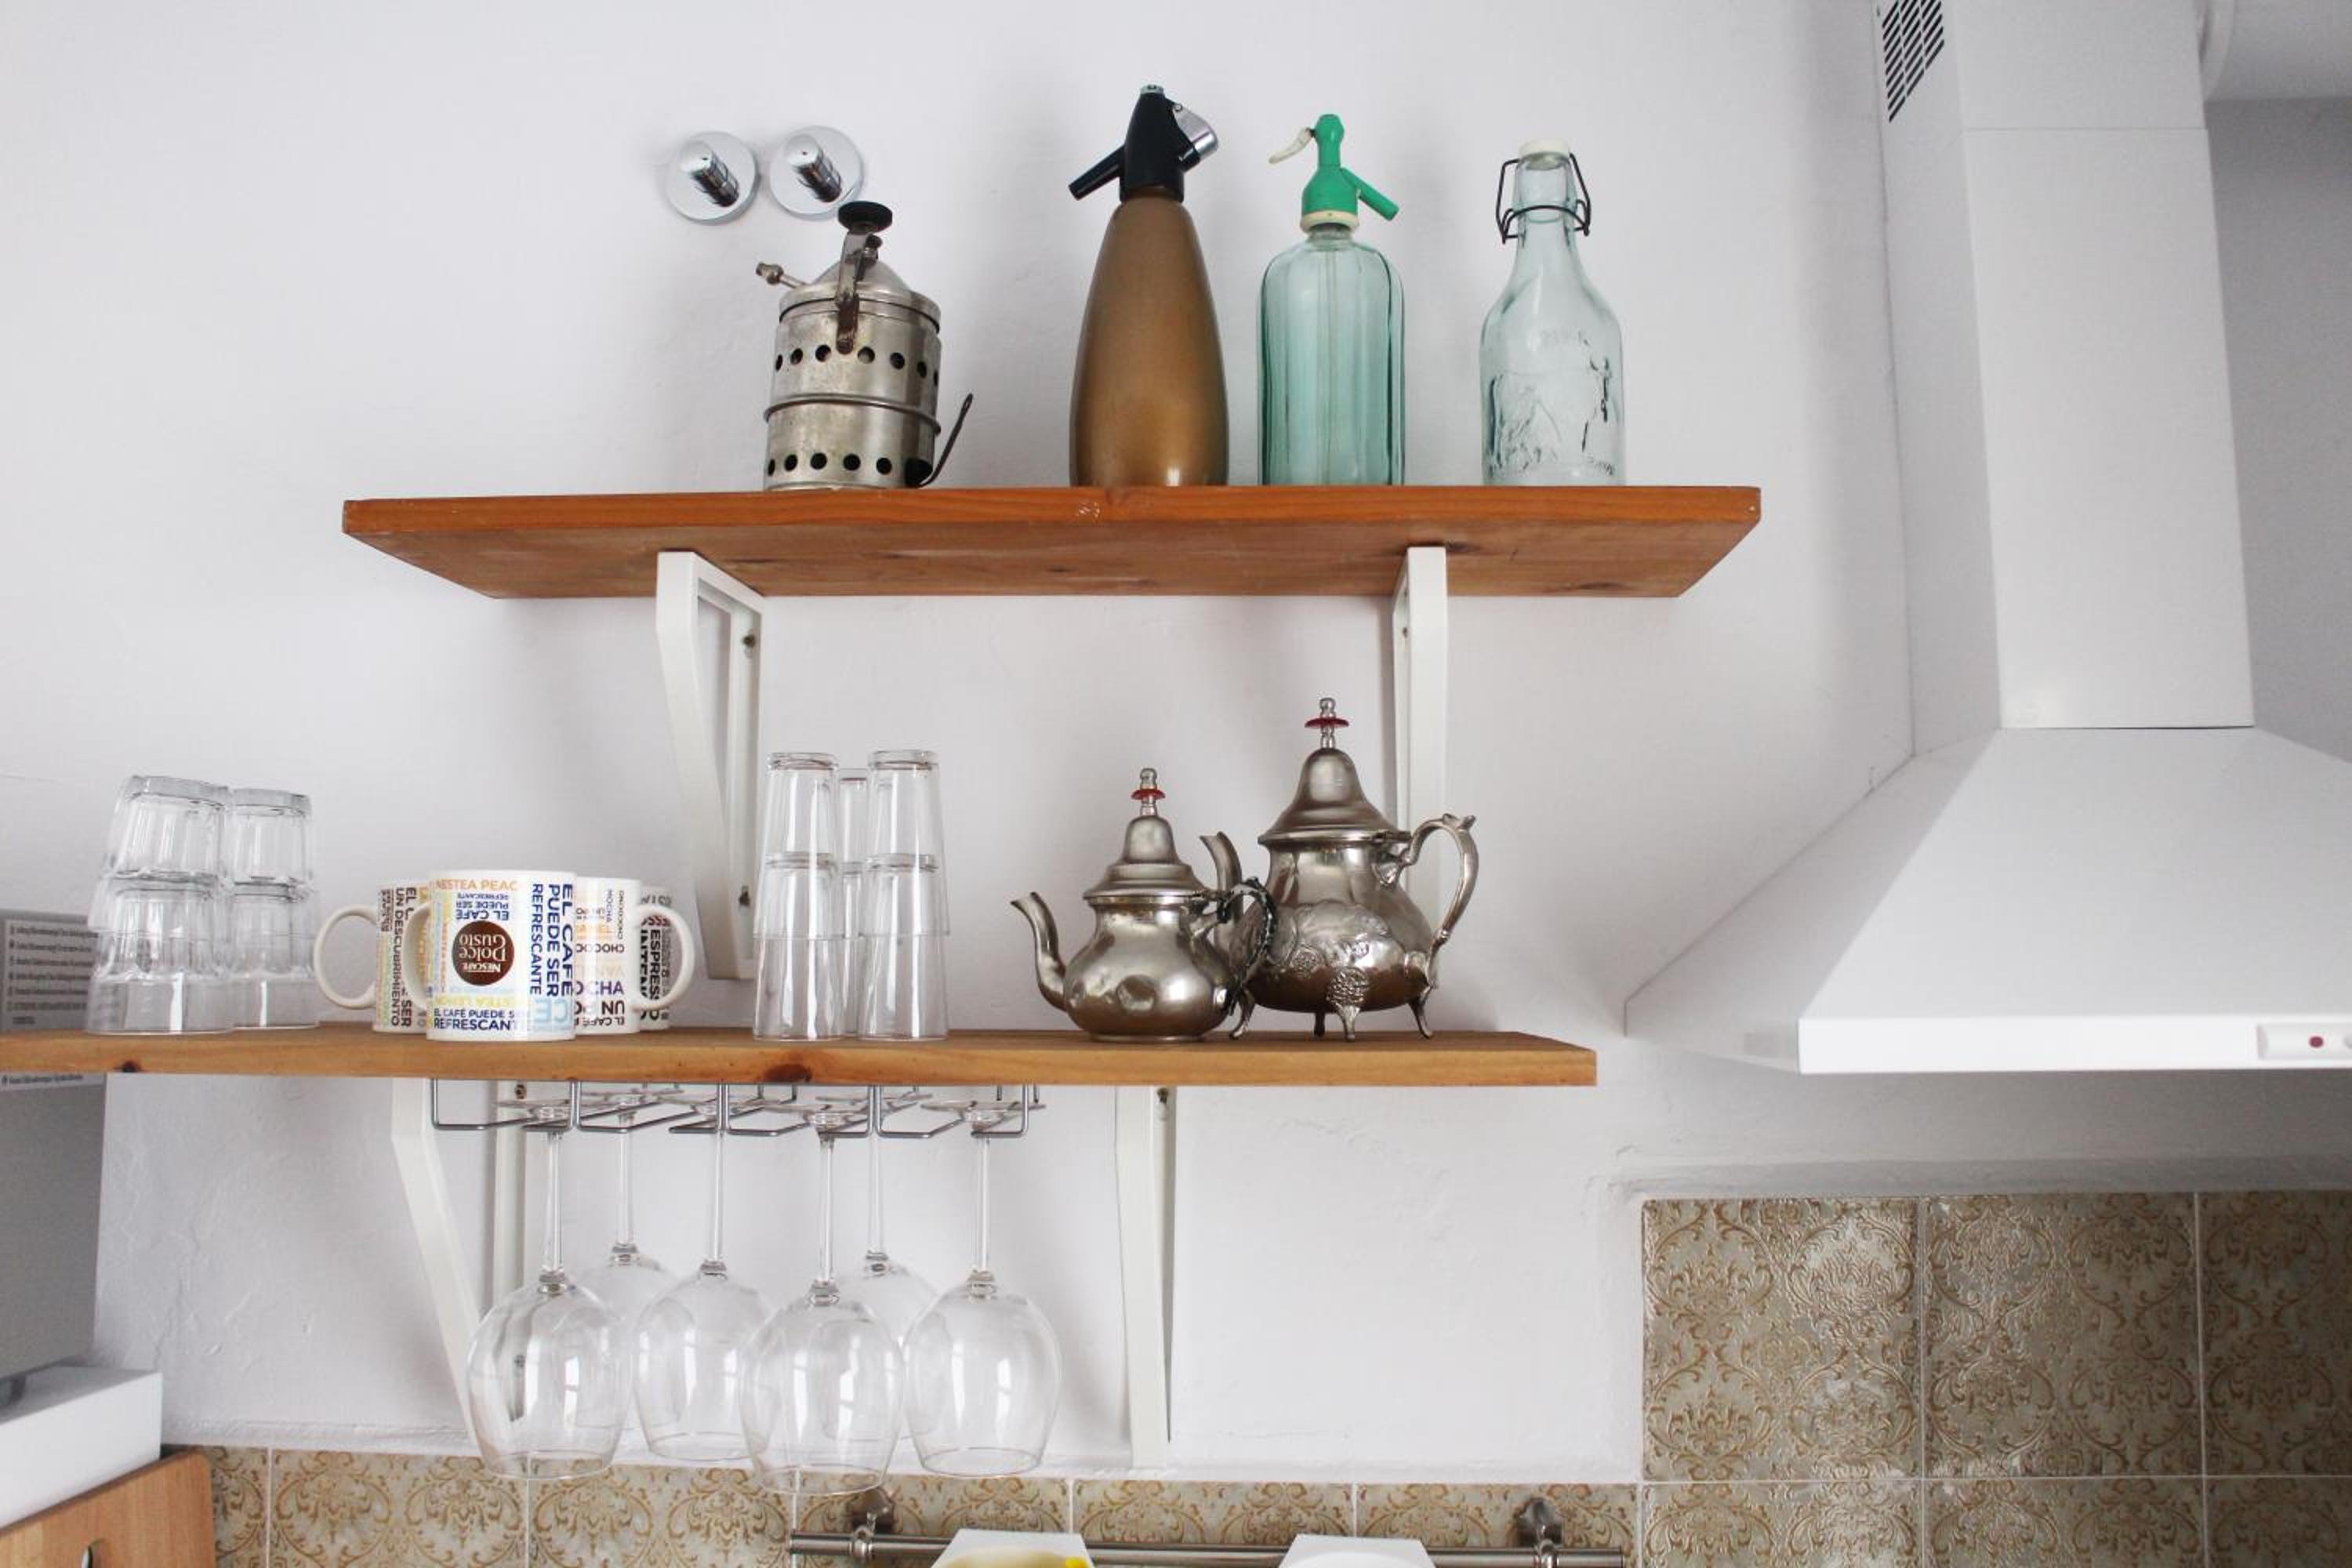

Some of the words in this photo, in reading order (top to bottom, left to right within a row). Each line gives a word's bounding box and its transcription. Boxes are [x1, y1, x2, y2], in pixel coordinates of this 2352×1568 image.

[406, 887, 416, 903] EL
[436, 879, 477, 890] NESTEA
[396, 887, 405, 906] UN
[563, 884, 573, 916] EL
[494, 910, 509, 920] EL
[547, 884, 560, 952] PUEDE
[530, 884, 543, 995] REFRESCANTE
[459, 947, 506, 961] Dolce
[391, 910, 404, 1026] DESCUBRIMIENTO
[546, 959, 559, 996] SER
[650, 929, 660, 1021] ESPRESO
[401, 1000, 412, 1026] SER
[468, 1010, 503, 1018] PUEDE
[602, 1000, 625, 1014] UN
